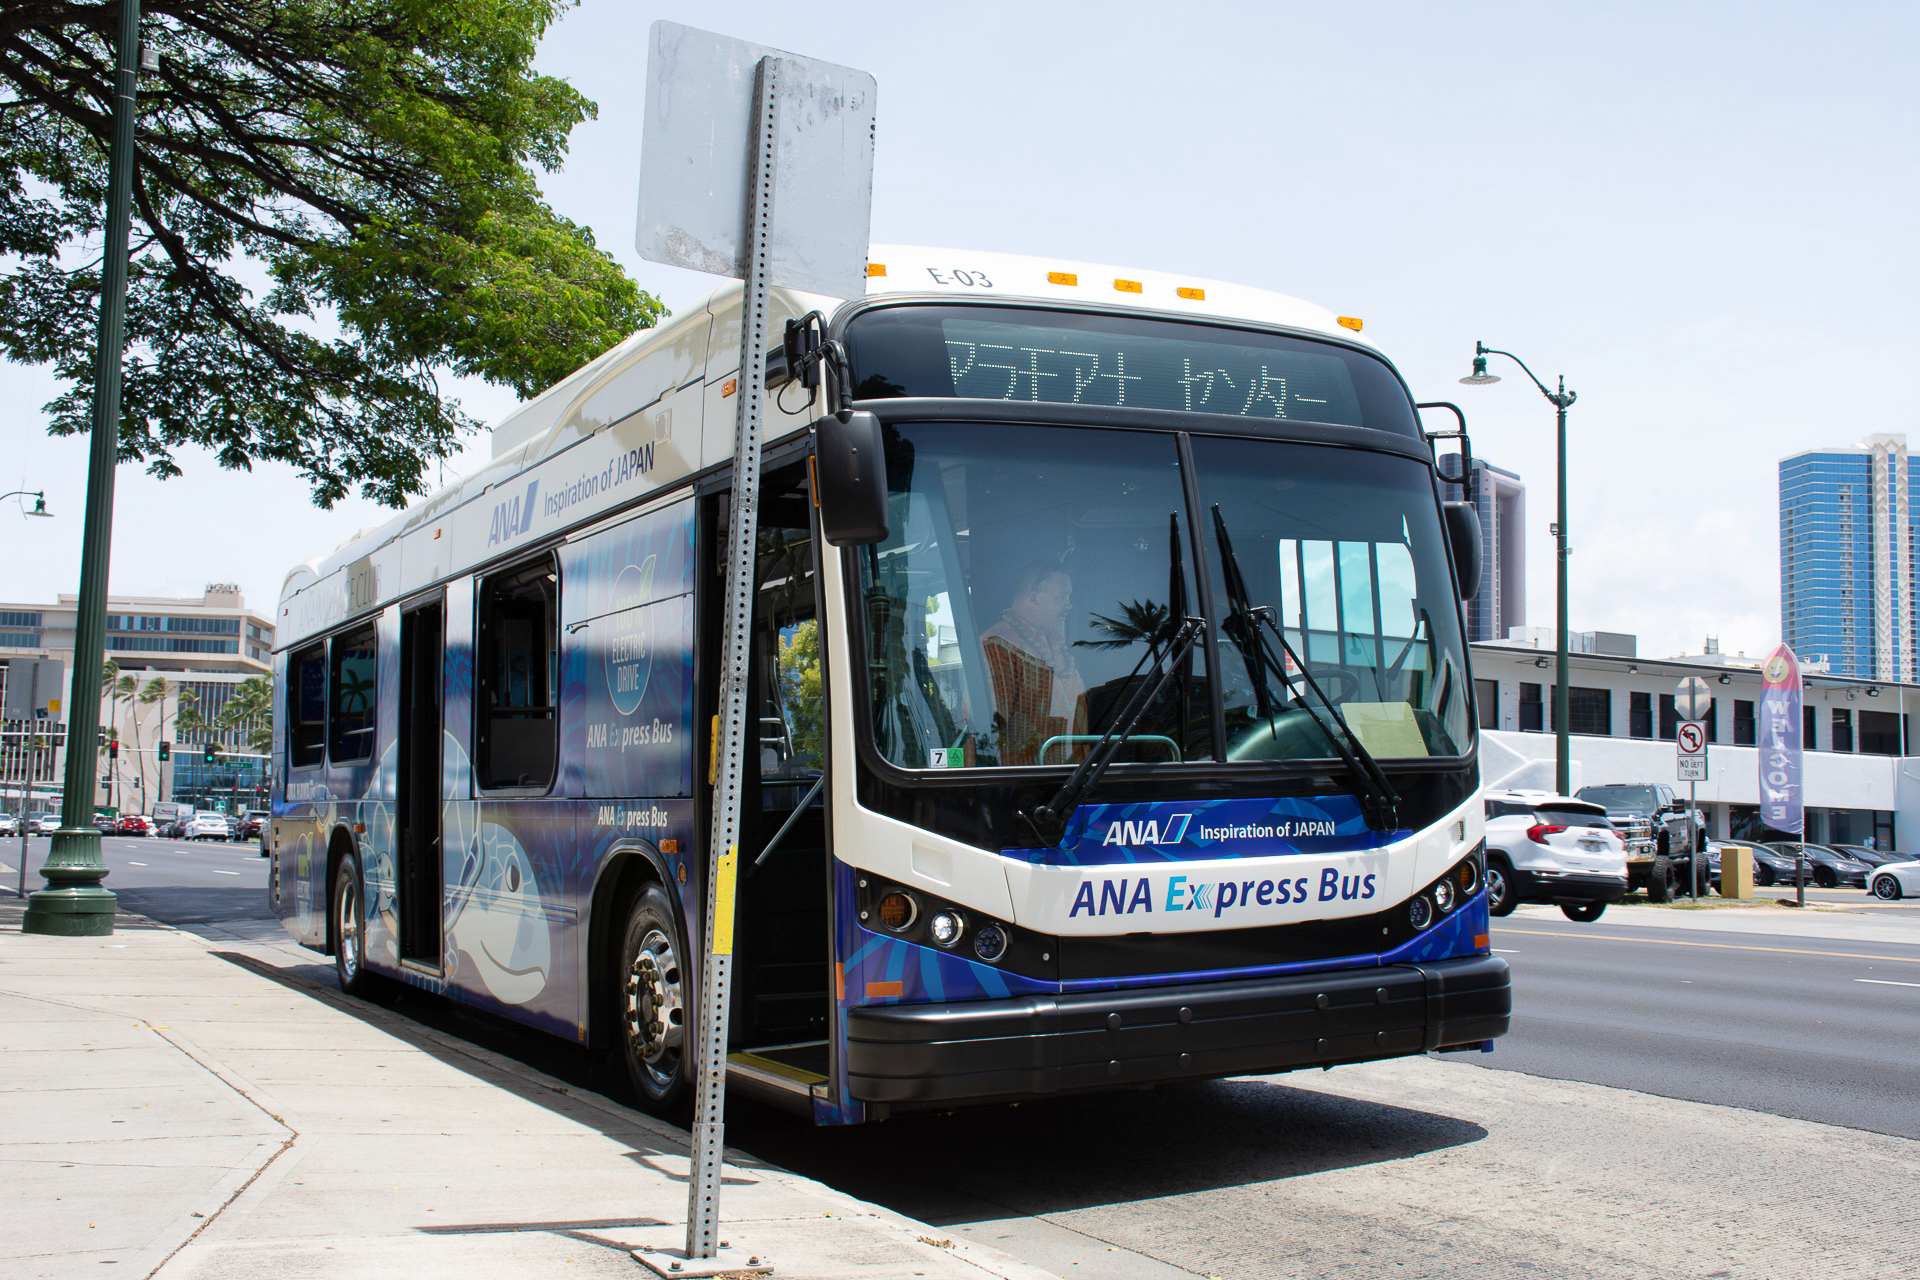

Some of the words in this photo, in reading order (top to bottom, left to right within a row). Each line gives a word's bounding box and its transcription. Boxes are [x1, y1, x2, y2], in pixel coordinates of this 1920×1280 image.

[926, 266, 994, 289] E-03
[488, 495, 519, 548] ANA
[544, 473, 598, 517] Inspiration
[600, 458, 614, 491] of
[614, 441, 655, 486] JAPAN
[355, 563, 383, 609] CLUB
[615, 593, 644, 632] 100%
[612, 631, 646, 665] ELECTRIC
[617, 663, 639, 693] DRIVE
[586, 723, 608, 749] ANA
[652, 717, 673, 744] Bus
[934, 752, 943, 764] 7
[1679, 760, 1689, 769] NO
[1690, 761, 1704, 769] LEFT
[1684, 769, 1699, 777] TURN
[597, 805, 616, 827] ANA
[651, 806, 668, 828] Bus
[1102, 820, 1161, 847] ANA
[1200, 823, 1274, 843] Inspiration
[1276, 821, 1290, 837] of
[1293, 820, 1336, 837] JAPAN
[1069, 877, 1153, 918] ANA
[1165, 875, 1308, 918] Express
[1317, 867, 1376, 902] Bus
